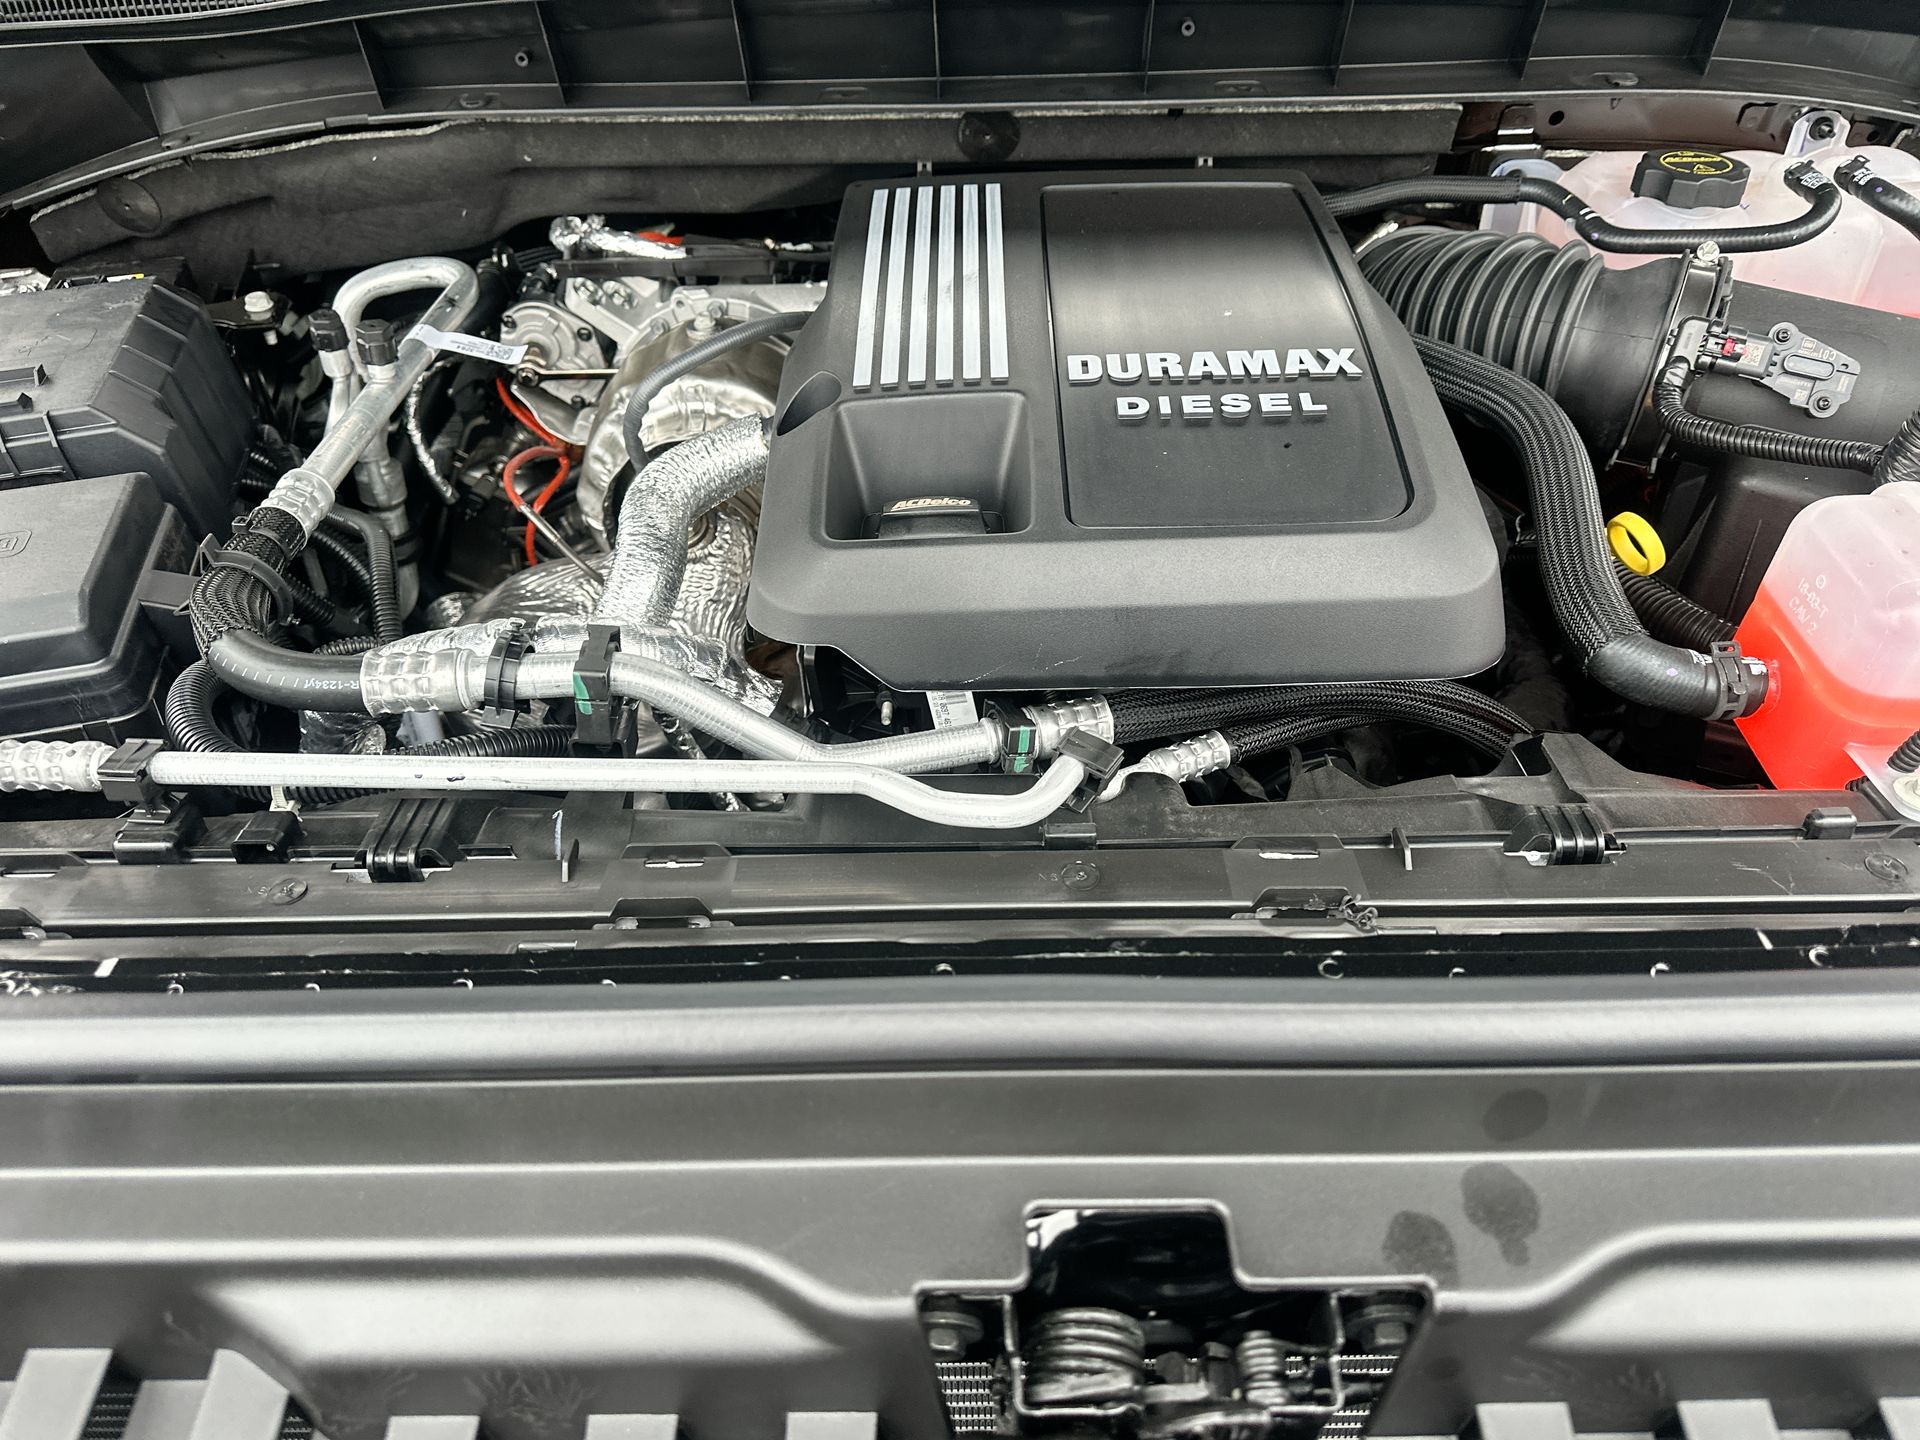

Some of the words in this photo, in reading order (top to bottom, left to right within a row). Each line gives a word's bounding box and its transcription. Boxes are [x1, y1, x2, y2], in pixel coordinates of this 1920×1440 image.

[1067, 348, 1363, 383] DURAMAX
[1116, 392, 1328, 419] DIESEL
[891, 497, 971, 511] ACDelco
[303, 678, 360, 690] R-1234yf
